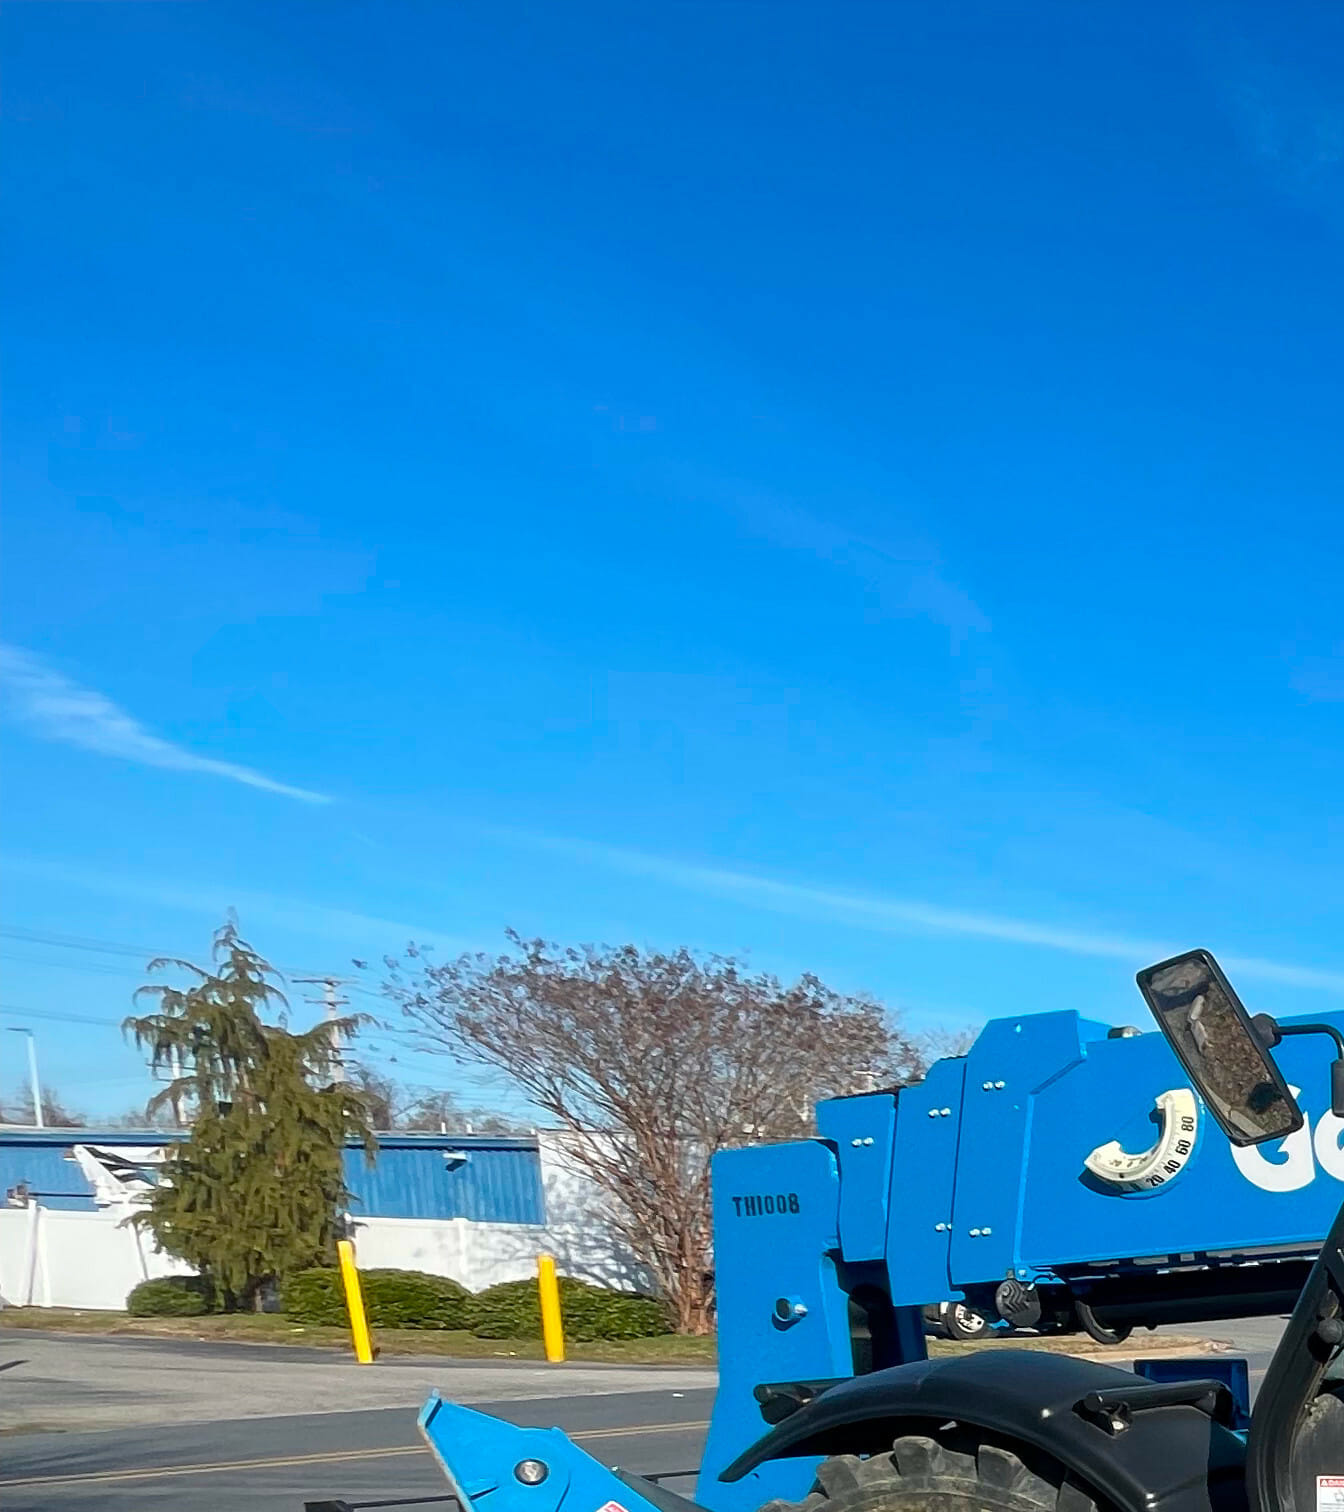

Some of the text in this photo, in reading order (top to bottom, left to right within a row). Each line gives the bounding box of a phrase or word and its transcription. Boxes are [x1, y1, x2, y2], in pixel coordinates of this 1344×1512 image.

[1145, 1115, 1195, 1187] 20 40 60 80
